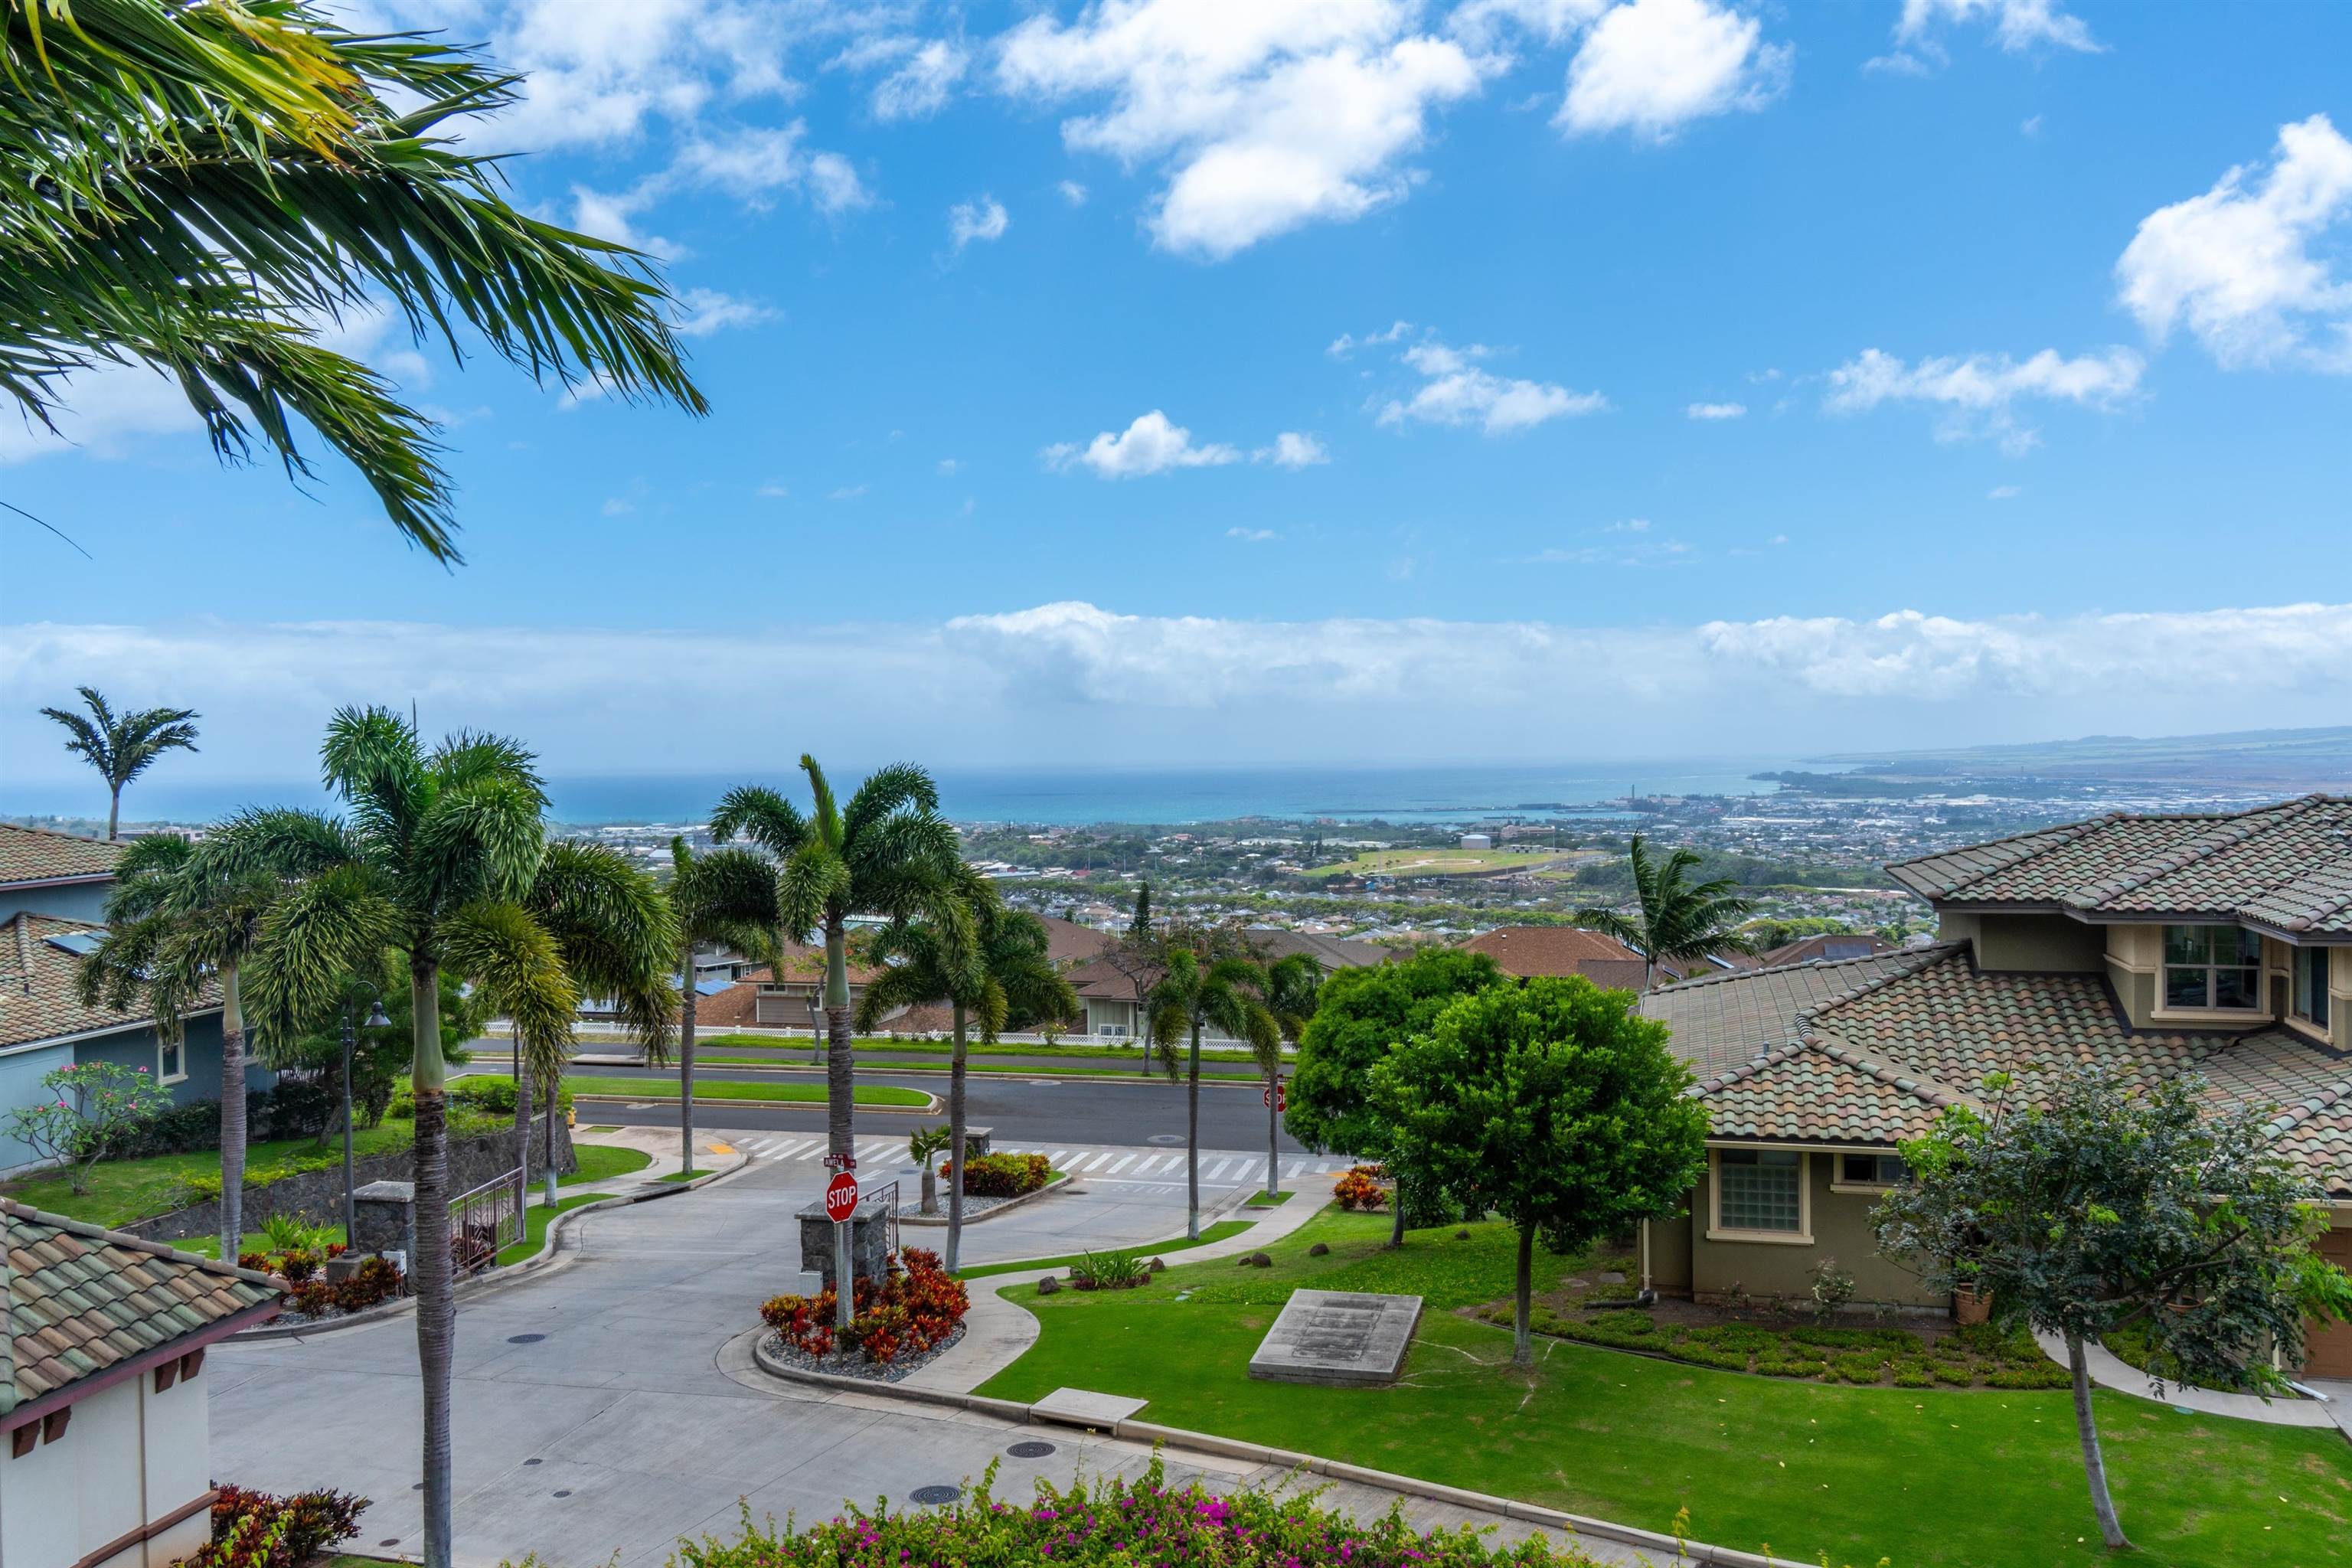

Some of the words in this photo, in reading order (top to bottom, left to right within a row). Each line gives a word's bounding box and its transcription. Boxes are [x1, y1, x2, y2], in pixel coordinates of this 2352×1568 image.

[1266, 1093, 1286, 1104] SOP
[1112, 1184, 1183, 1194] STOP
[828, 1186, 856, 1209] STOP
